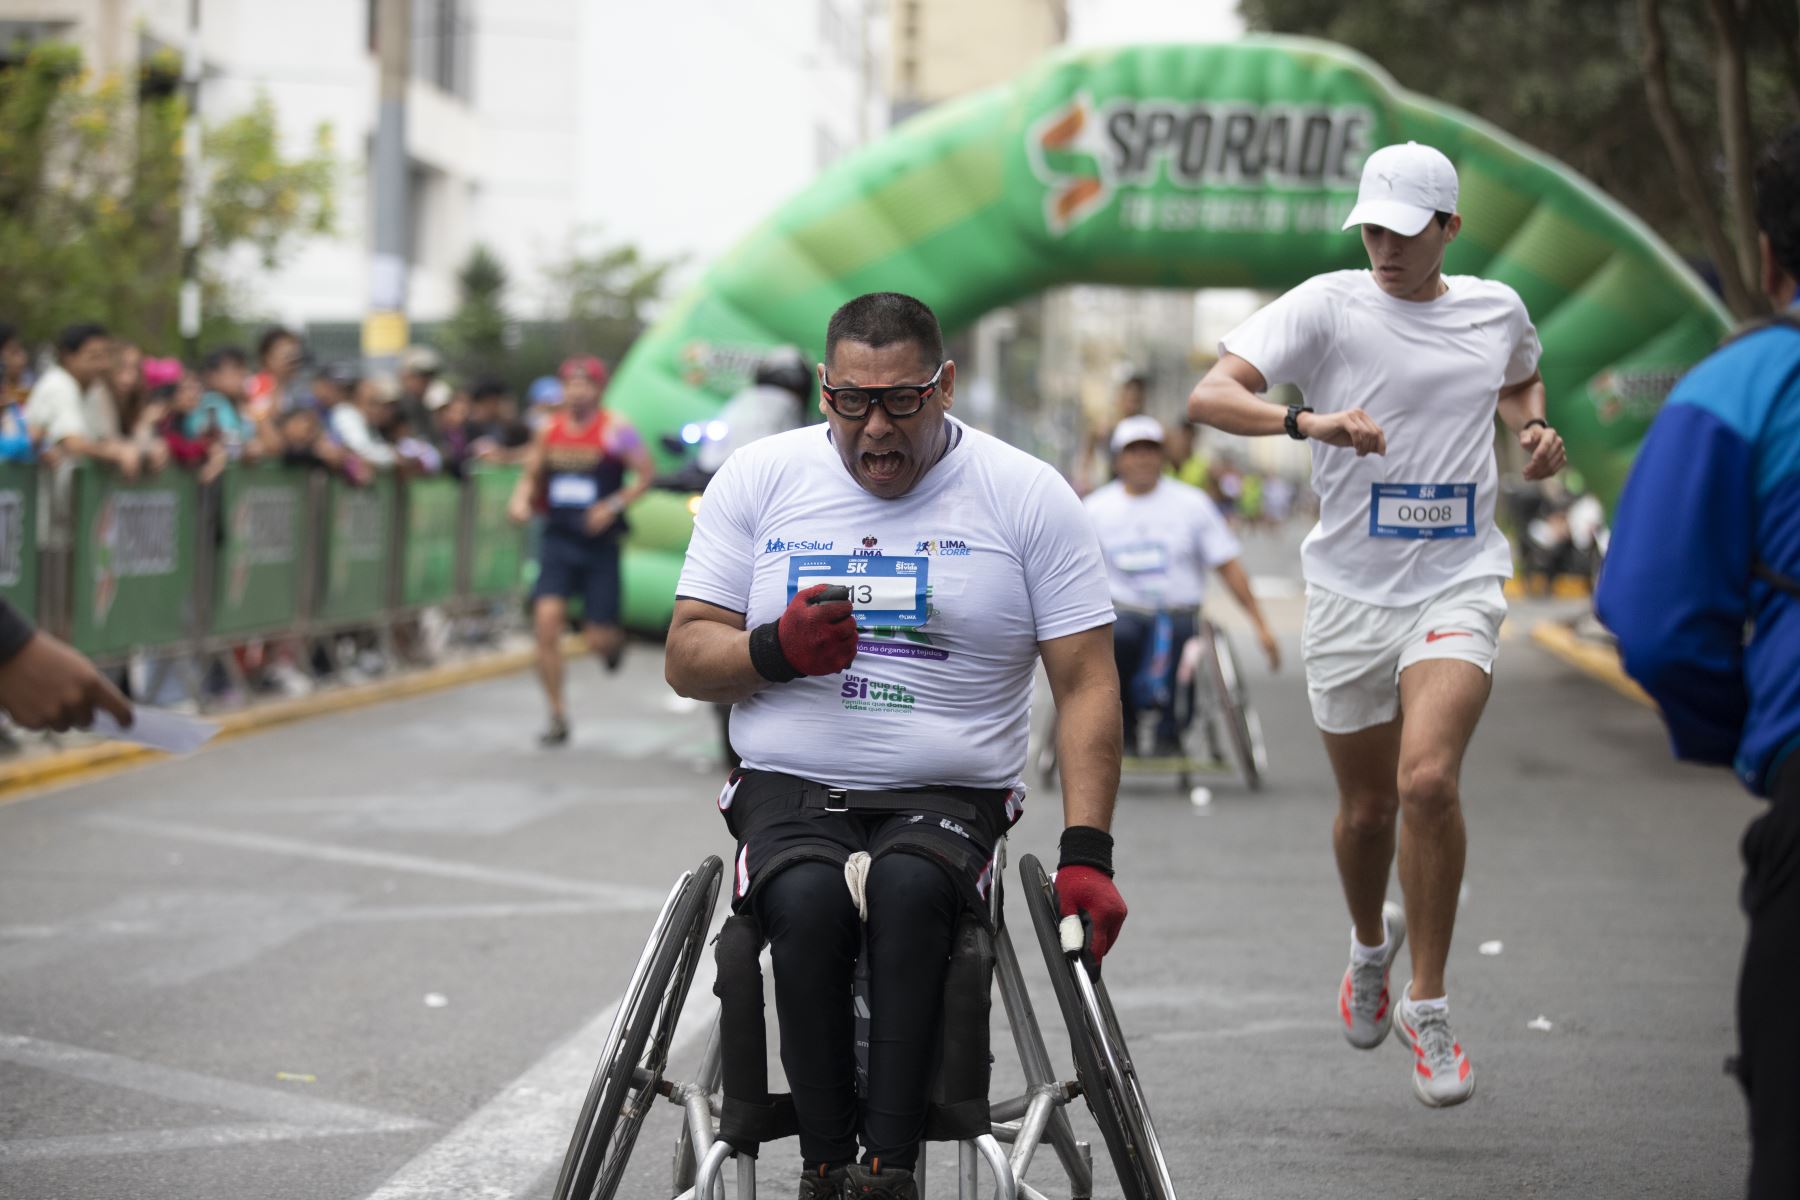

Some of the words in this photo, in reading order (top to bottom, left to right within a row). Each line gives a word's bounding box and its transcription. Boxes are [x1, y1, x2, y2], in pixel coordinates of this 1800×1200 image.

[1105, 107, 1368, 181] SPORADE
[1398, 506, 1452, 522] 0008
[787, 541, 833, 550] EsSalud
[846, 563, 867, 573] 5K
[880, 645, 910, 654] órganos
[917, 649, 943, 657] tejidos
[845, 674, 859, 682] Un
[869, 681, 890, 689] que
[893, 683, 906, 691] da
[869, 689, 915, 703] vida
